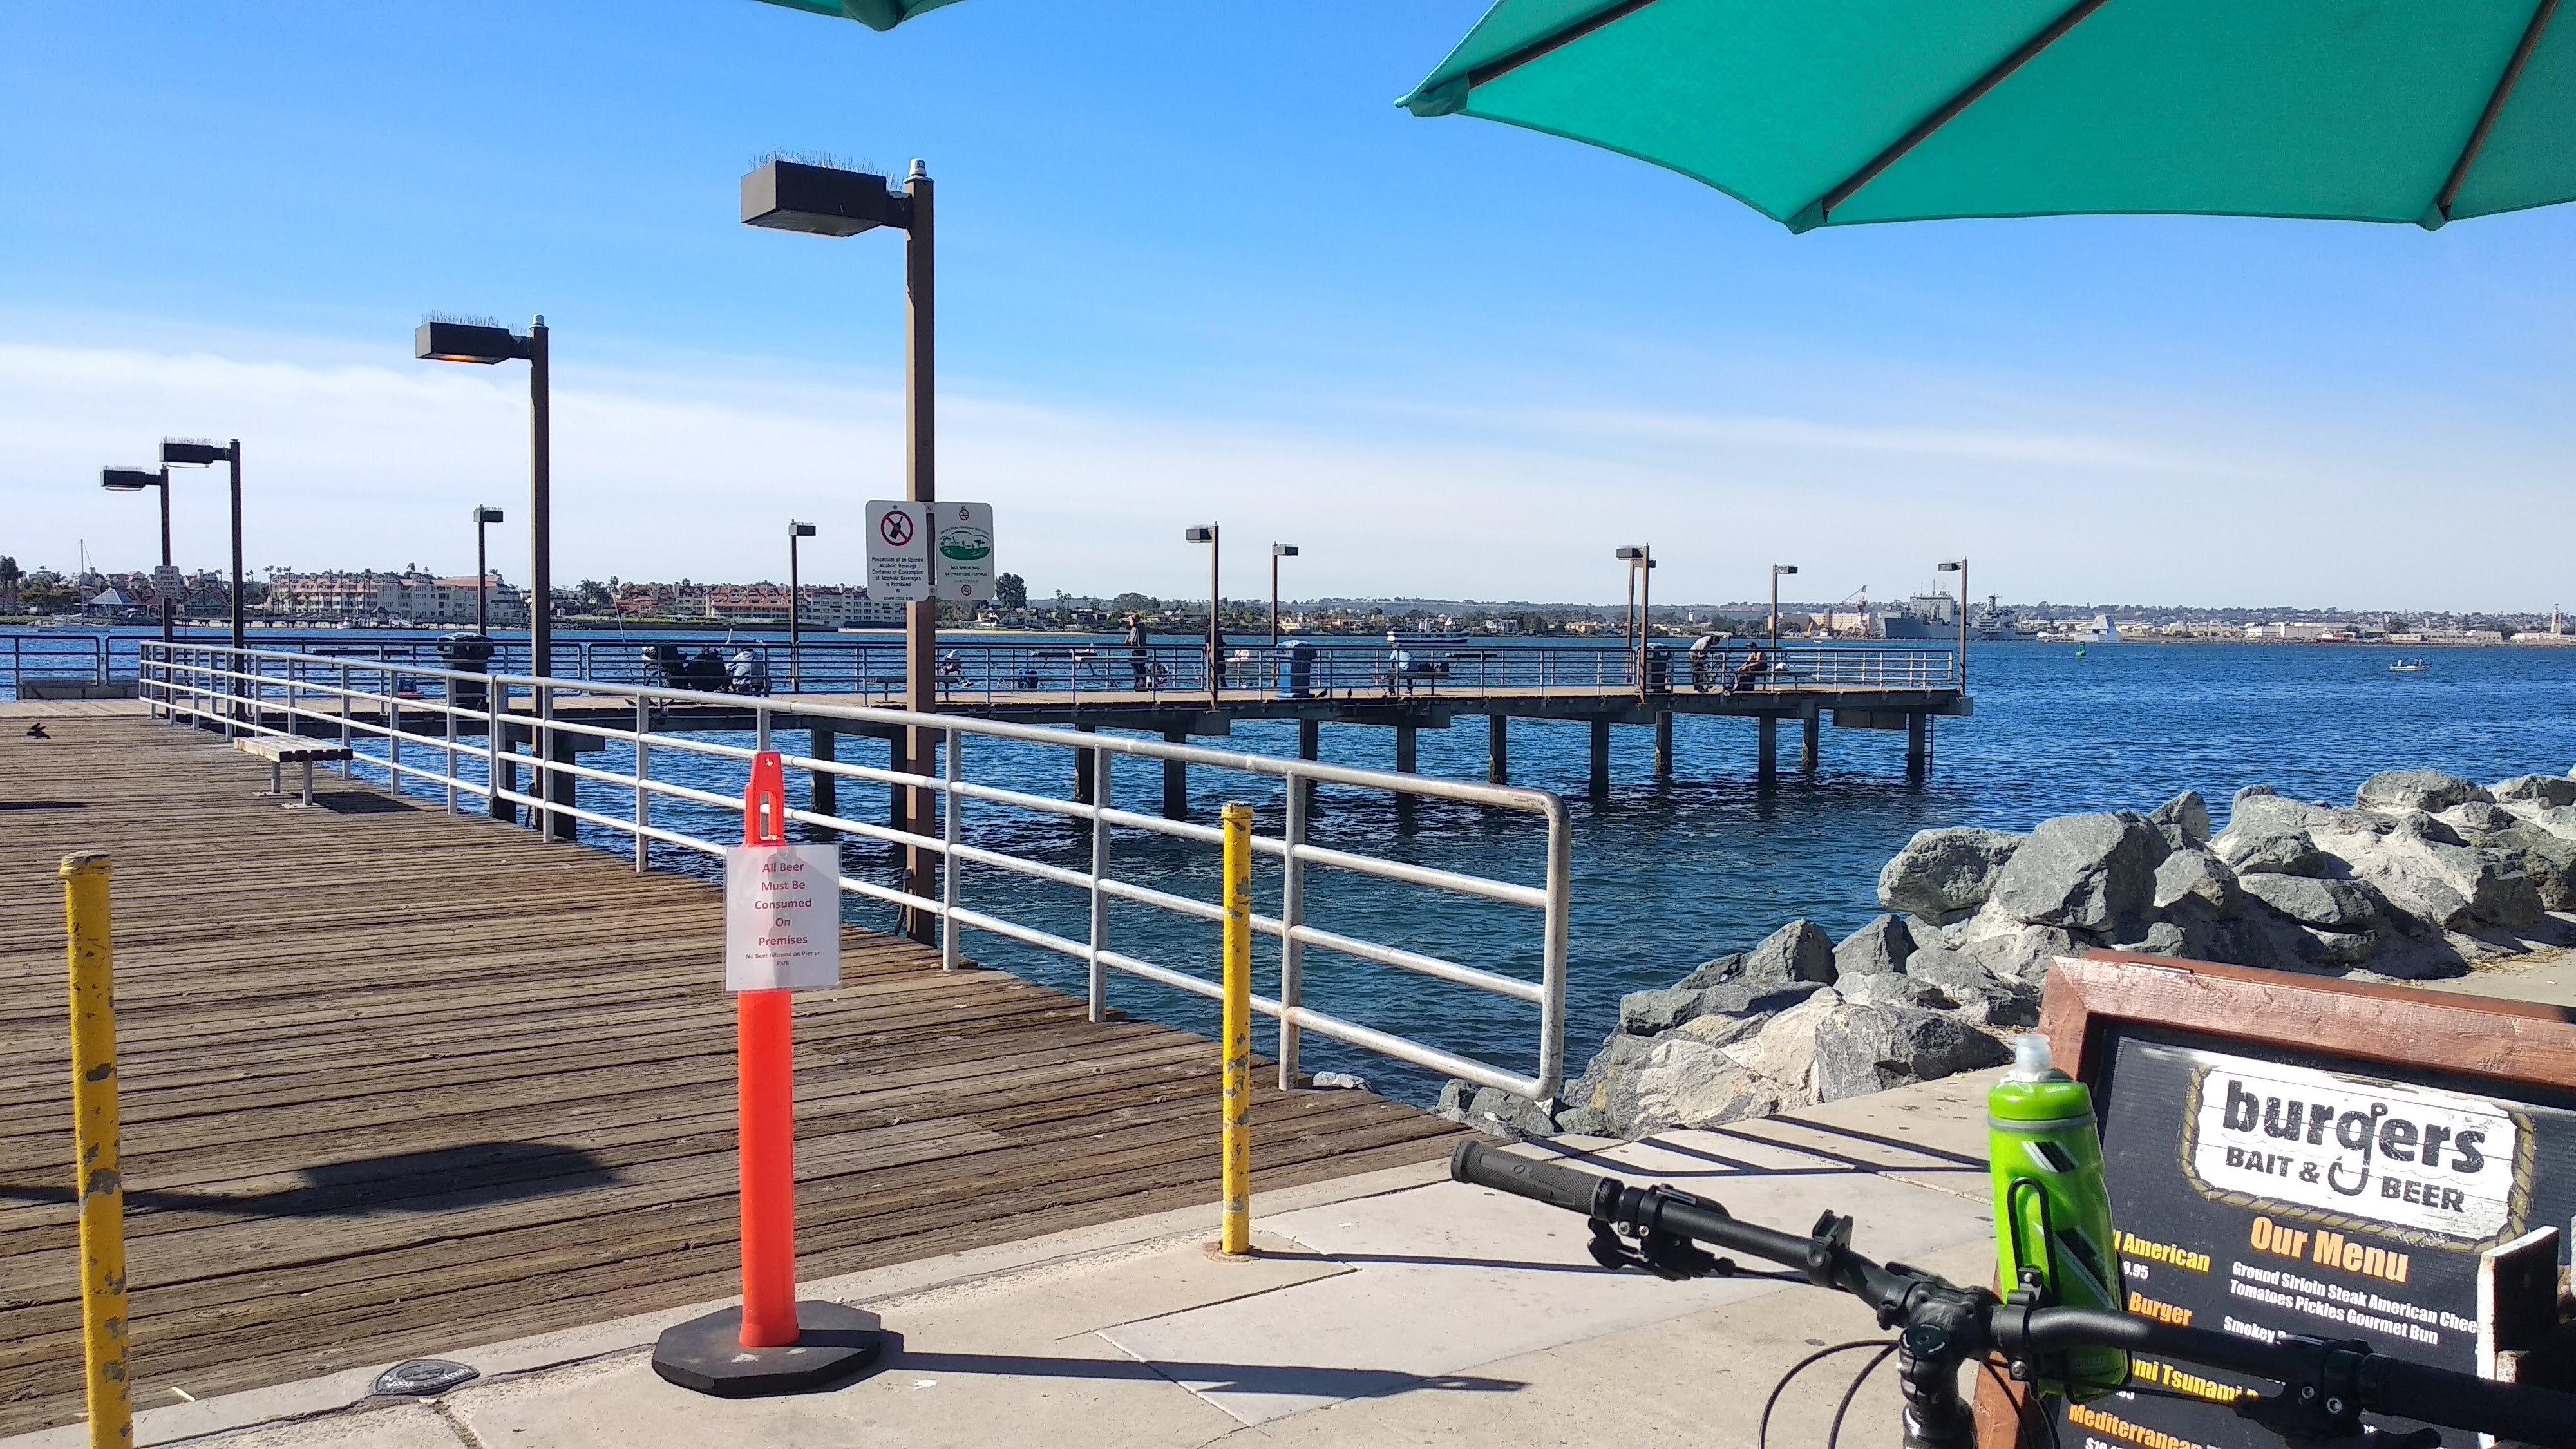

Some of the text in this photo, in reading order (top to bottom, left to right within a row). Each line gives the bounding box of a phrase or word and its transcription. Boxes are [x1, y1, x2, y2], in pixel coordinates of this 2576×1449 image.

[761, 880, 806, 891] Must Be
[762, 862, 804, 873] All Beer
[755, 898, 811, 909] Consumed
[759, 935, 808, 946] Premises
[775, 918, 791, 927] On
[2223, 1079, 2485, 1196] burgers
[2226, 1146, 2465, 1213] BAIT & BEER
[2122, 1233, 2211, 1273] American
[2251, 1217, 2409, 1283] Our Menu
[2123, 1260, 2149, 1280] 8.95
[2128, 1291, 2193, 1327] Burger
[2230, 1279, 2439, 1345] Tomatoes Pickles Gourmet Bun
[2233, 1261, 2477, 1334] Ground Sirloin Steak American Chee
[2224, 1316, 2276, 1343] Smokey
[2162, 1363, 2243, 1401] Tsunami
